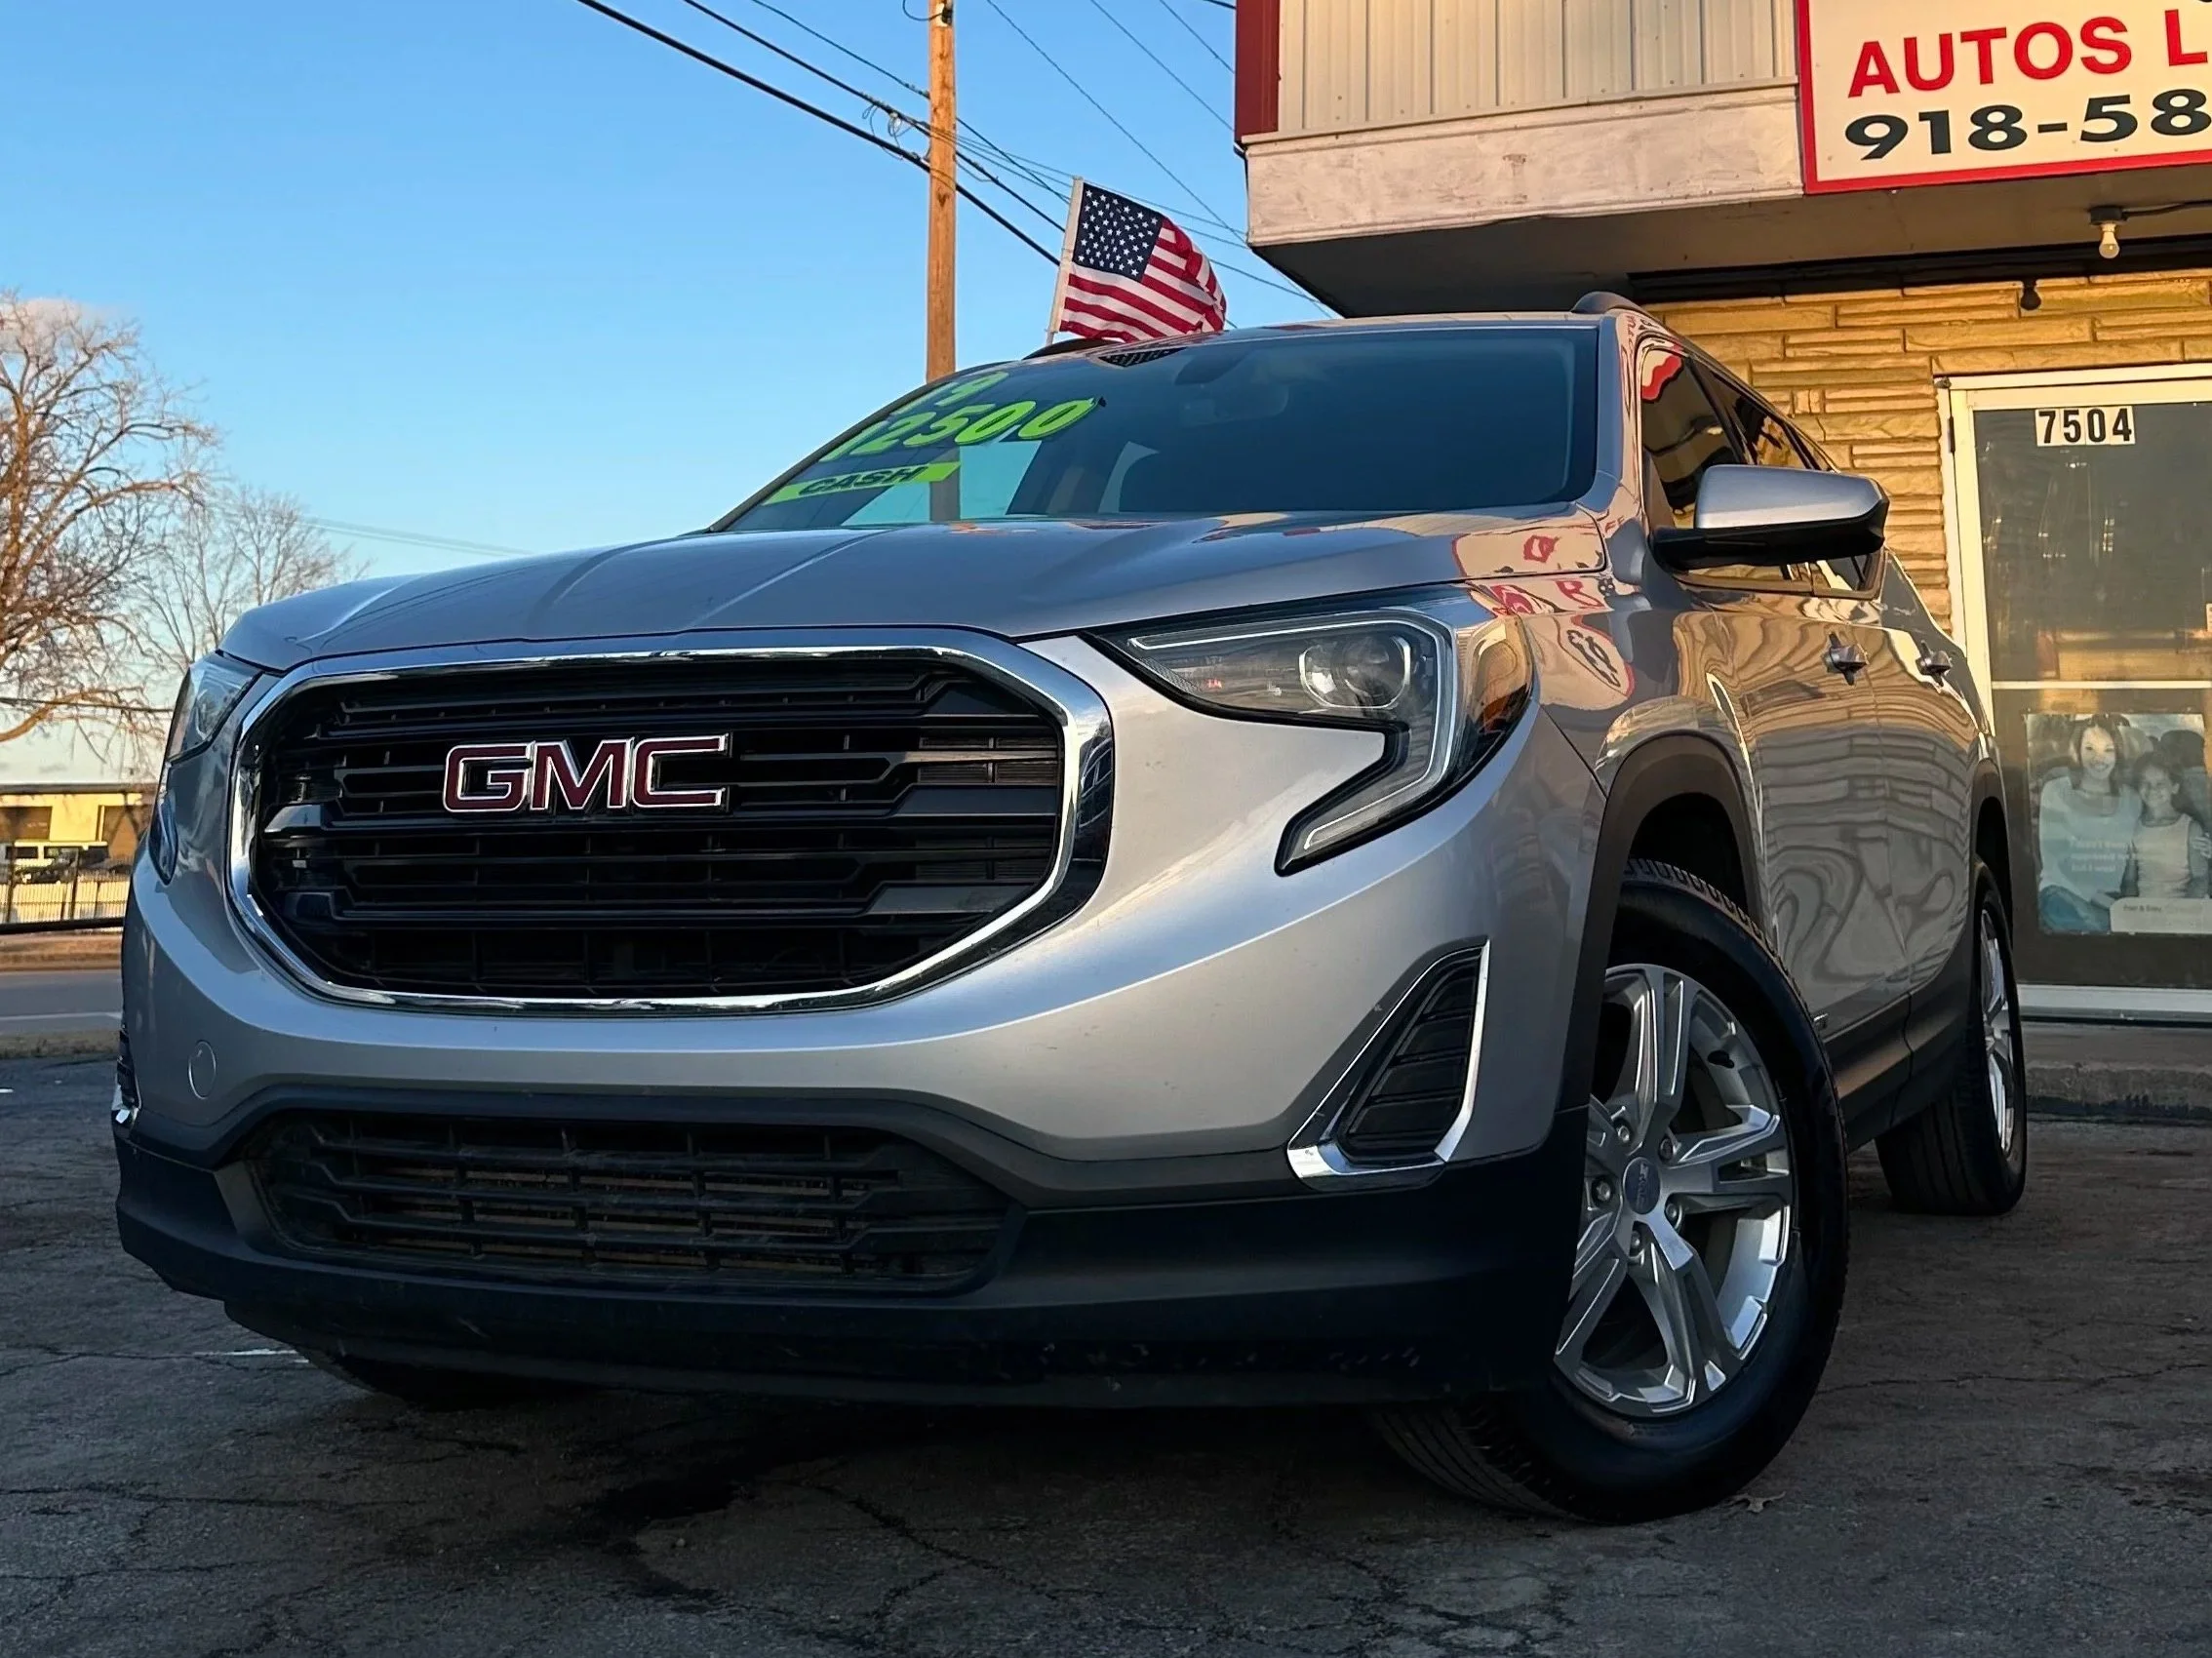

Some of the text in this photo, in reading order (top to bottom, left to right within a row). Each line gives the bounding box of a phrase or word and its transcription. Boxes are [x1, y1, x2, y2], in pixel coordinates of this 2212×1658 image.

[1847, 9, 2208, 98] AUTOS L
[1845, 89, 2212, 160] 918-58
[2038, 409, 2132, 443] 7504
[798, 465, 927, 495] CASH
[443, 734, 729, 812] GMC
